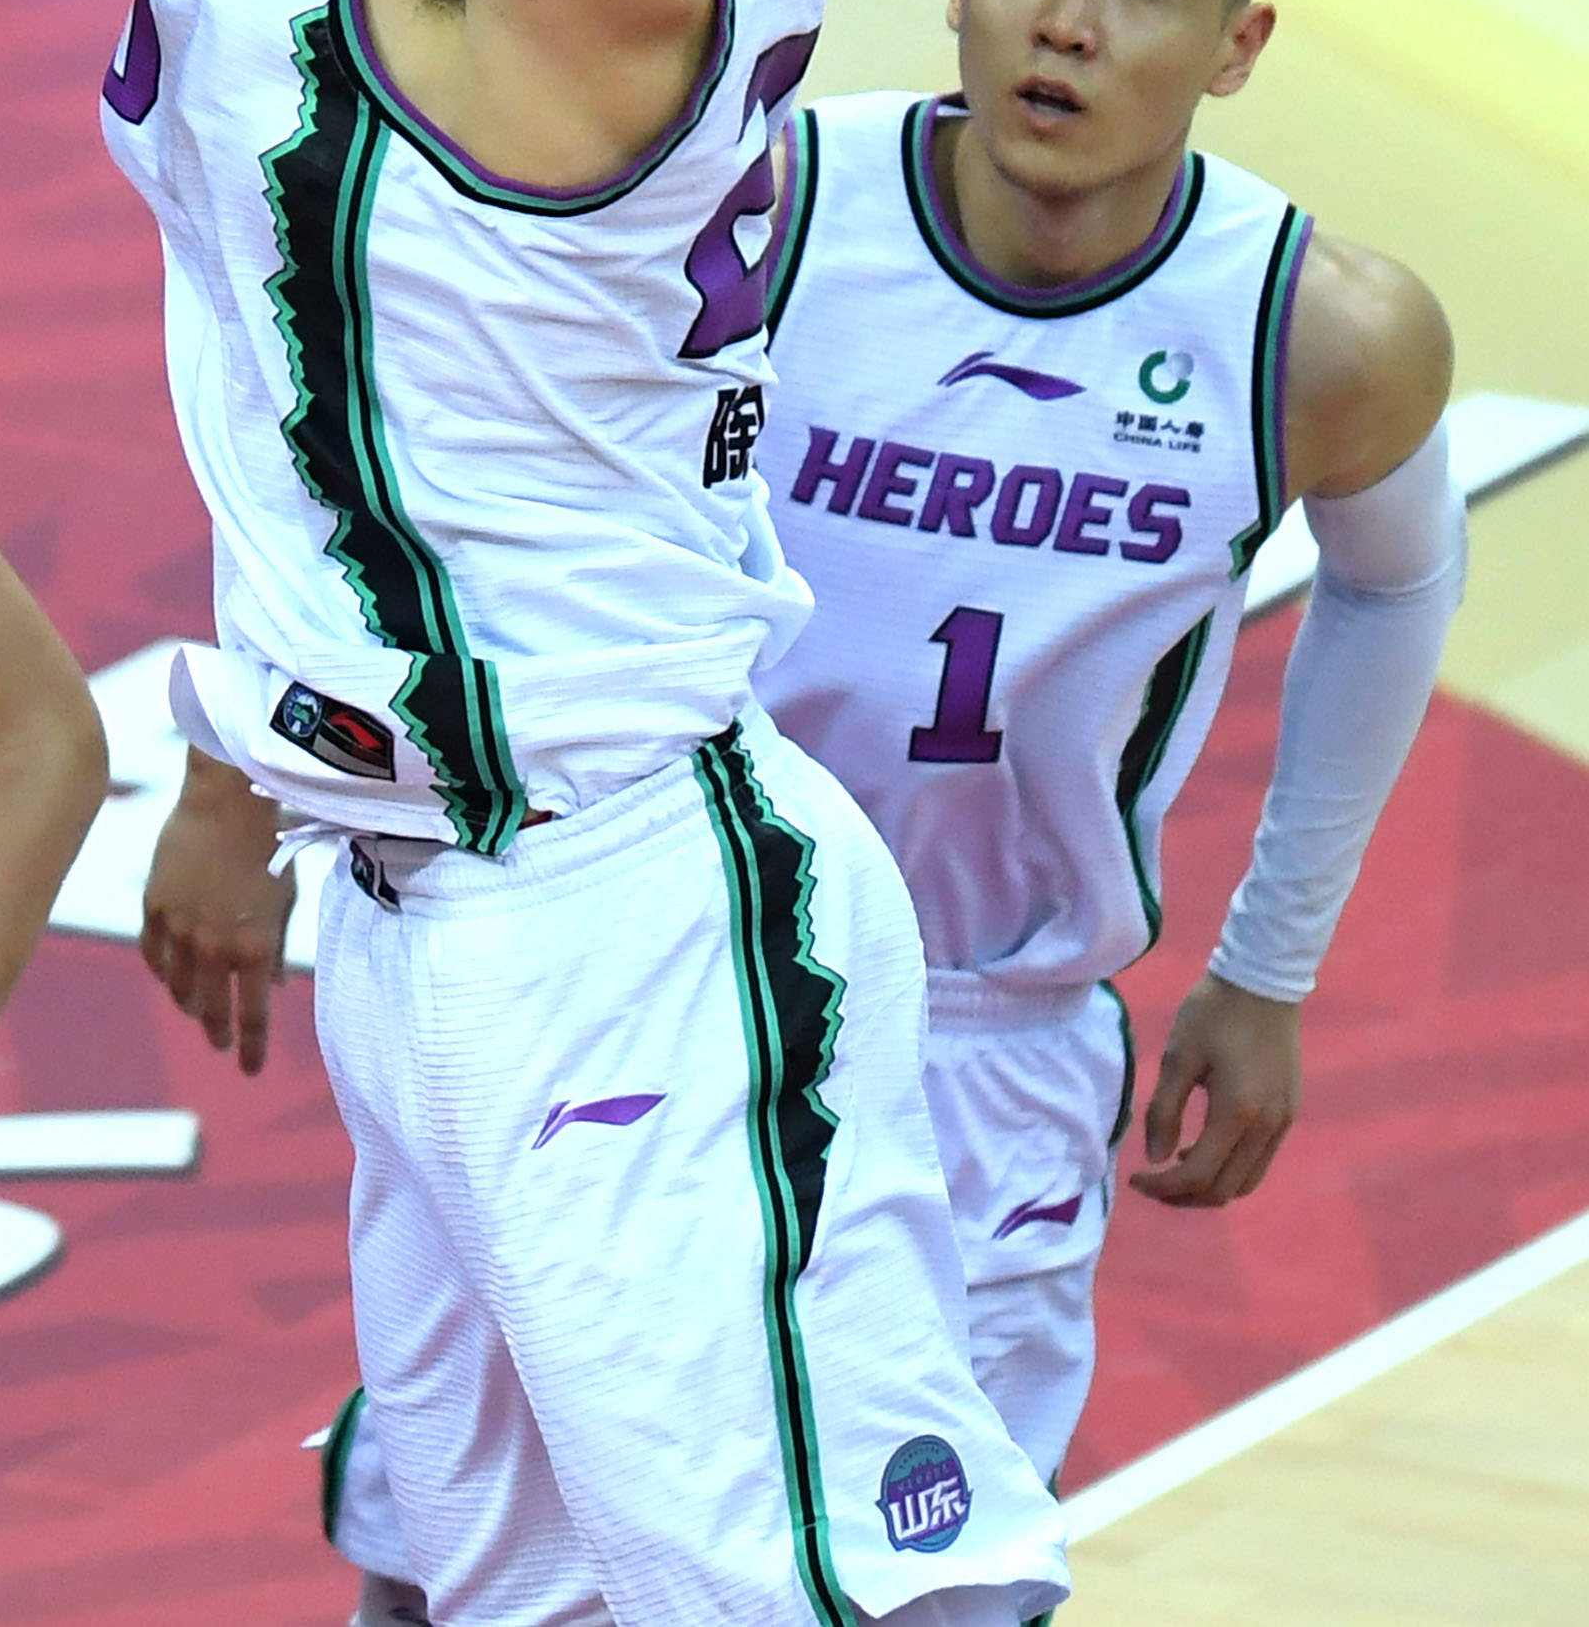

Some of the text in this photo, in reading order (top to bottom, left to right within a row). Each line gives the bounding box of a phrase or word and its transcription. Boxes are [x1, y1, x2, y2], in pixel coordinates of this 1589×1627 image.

[790, 425, 1192, 565] HEROES
[1113, 432, 1162, 448] CHINA
[907, 605, 1005, 766] 1
